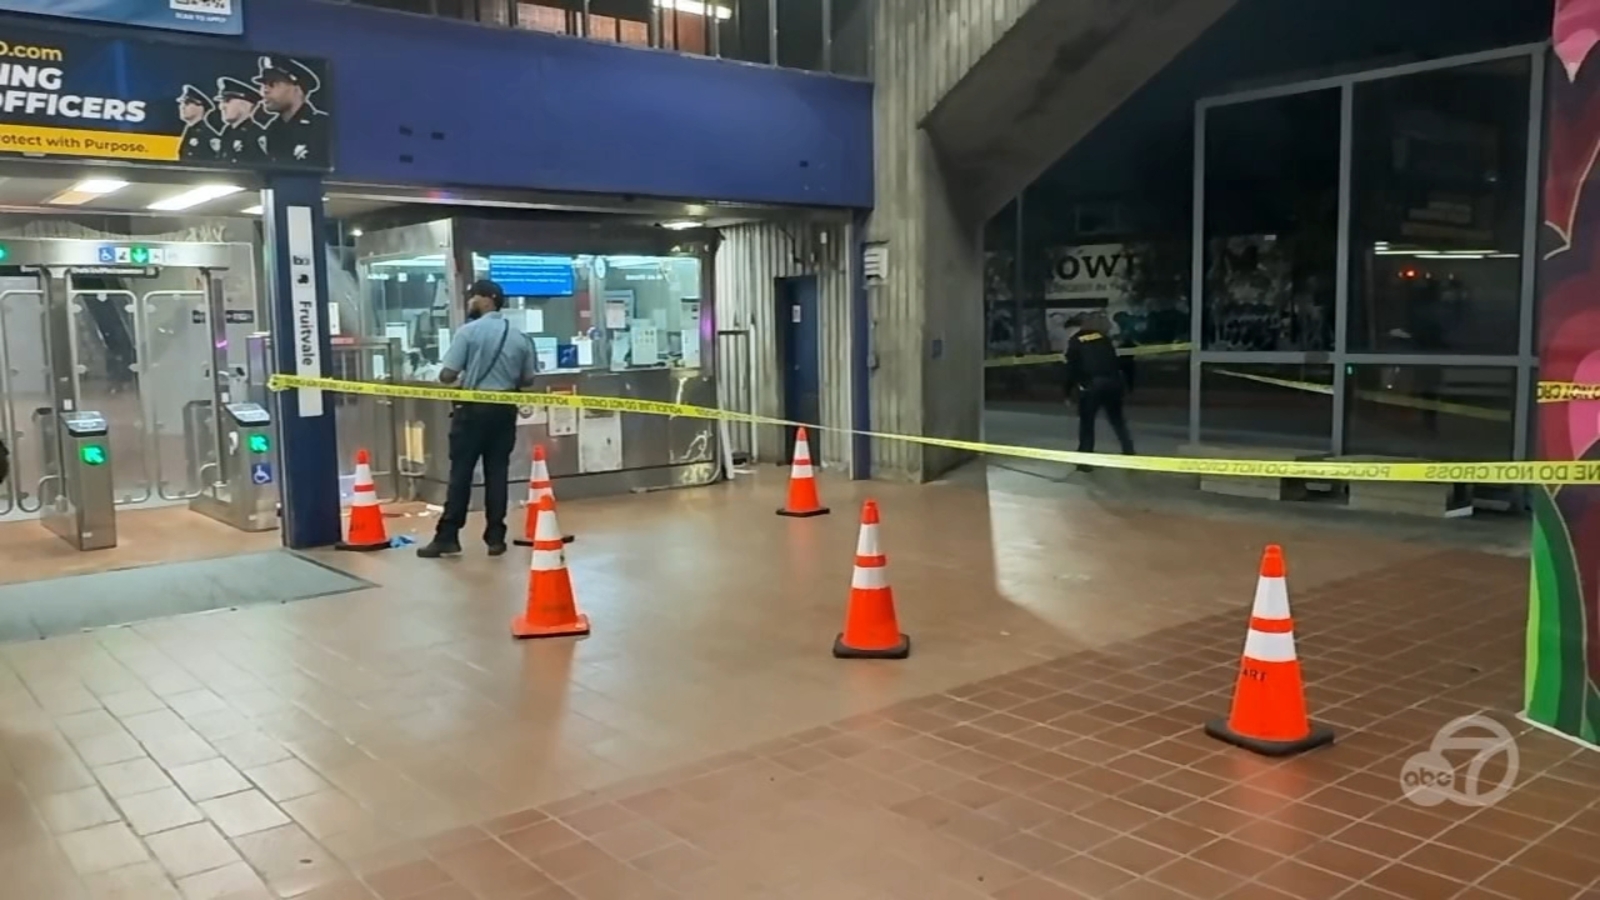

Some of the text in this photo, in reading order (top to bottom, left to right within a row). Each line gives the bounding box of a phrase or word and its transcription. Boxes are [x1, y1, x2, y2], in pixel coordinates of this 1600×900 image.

[0, 90, 146, 122] FFICERS
[46, 137, 80, 149] with
[84, 138, 149, 153] Purpose.
[299, 301, 315, 367] Fruitvale
[657, 405, 683, 414] POLICE
